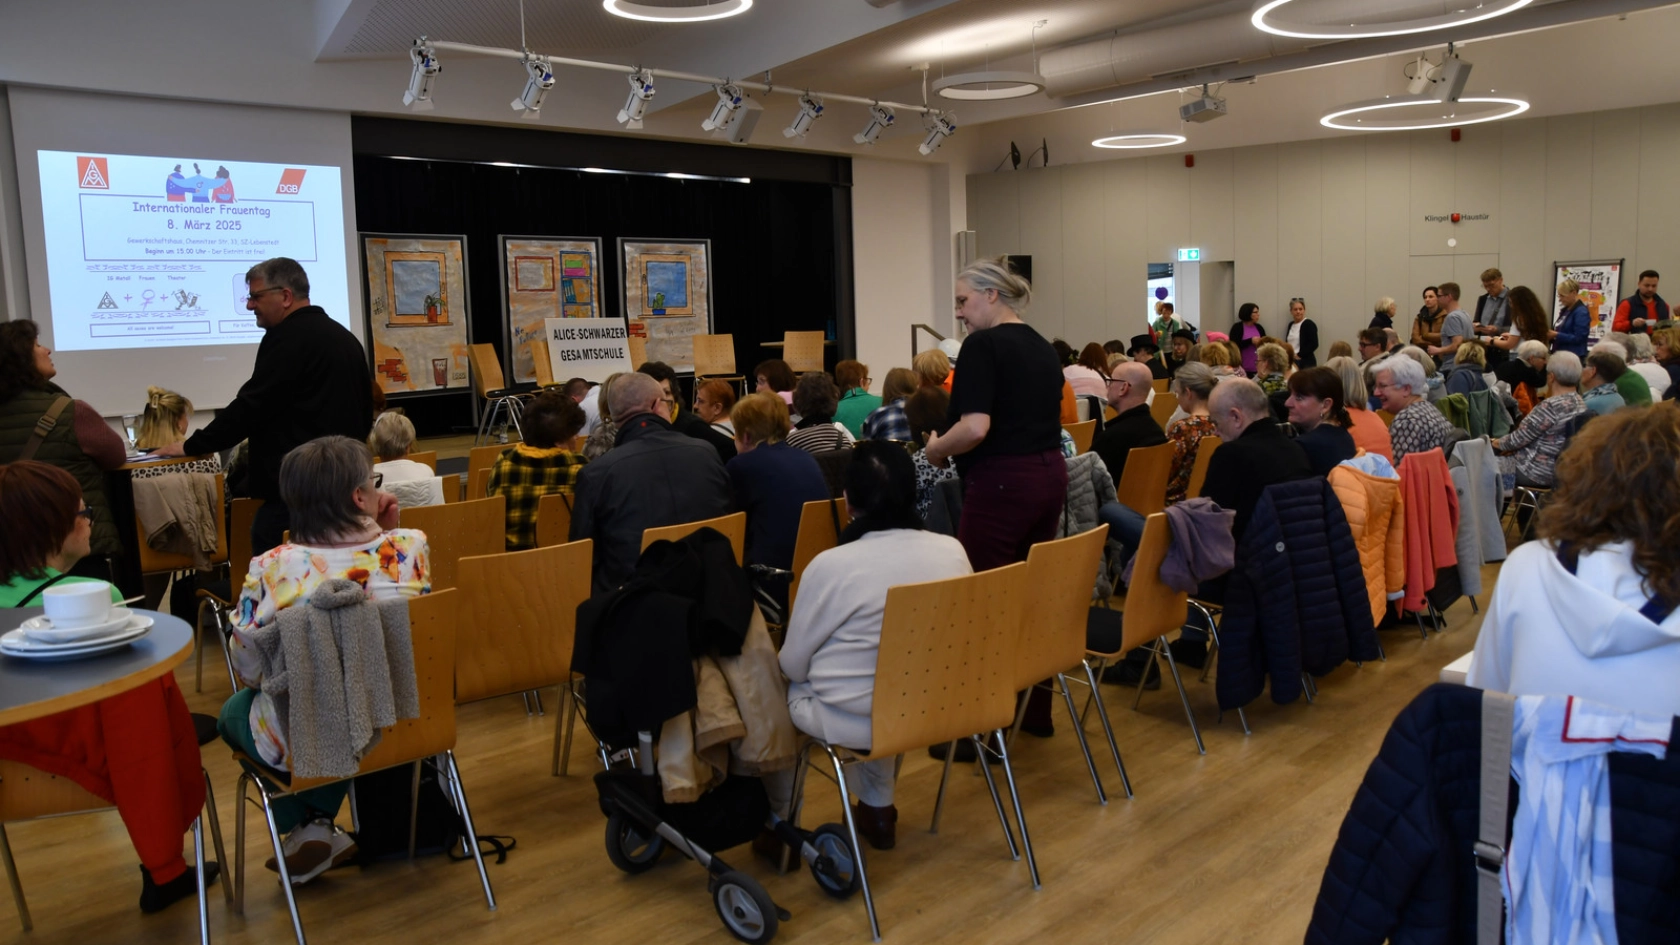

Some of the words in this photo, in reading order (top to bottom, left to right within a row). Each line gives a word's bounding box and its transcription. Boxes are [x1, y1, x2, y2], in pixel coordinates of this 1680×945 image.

[279, 183, 298, 193] DGB
[132, 202, 216, 215] Internationaler
[219, 204, 271, 218] Frauentag
[1424, 214, 1449, 223] Klingel
[1461, 213, 1489, 221] Haustür
[167, 219, 178, 230] 8.
[184, 220, 211, 231] März
[215, 220, 242, 231] 2025
[145, 247, 165, 255] Beginn
[553, 327, 626, 341] ALICE-SCHWARZER
